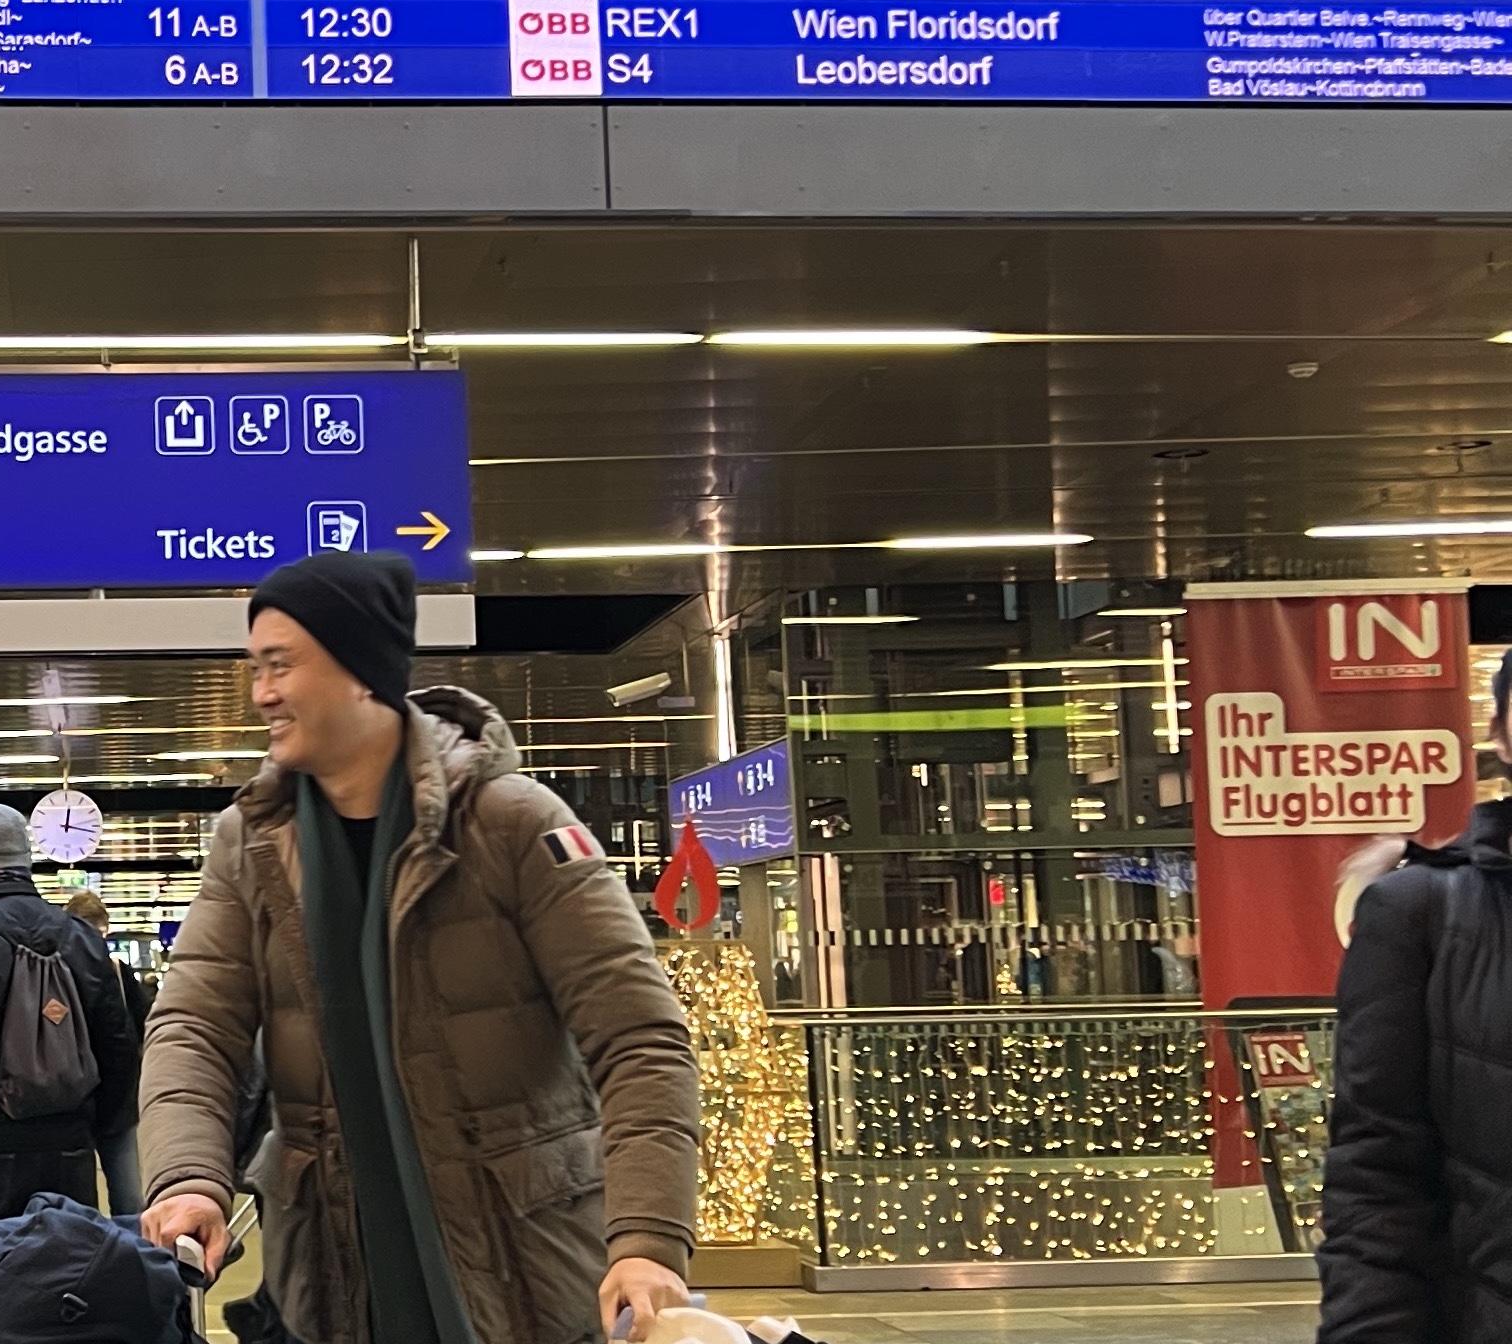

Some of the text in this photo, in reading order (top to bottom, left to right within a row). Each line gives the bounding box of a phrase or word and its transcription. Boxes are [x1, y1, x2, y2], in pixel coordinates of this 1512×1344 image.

[149, 8, 236, 37] 11 A-B
[301, 8, 391, 37] 12:30
[607, 8, 697, 37] REX1
[793, 10, 1059, 40] Wien Floridsdorf
[166, 55, 238, 84] 6 A-B
[302, 54, 393, 84] 12:32
[608, 54, 653, 83] S4
[797, 54, 993, 85] Leobersdorf
[157, 528, 275, 559] Tickets
[1329, 600, 1440, 661] IN
[1218, 703, 1273, 738] Ihr
[1219, 740, 1449, 779] INTERSPAR
[1221, 782, 1414, 827] Flugblatt
